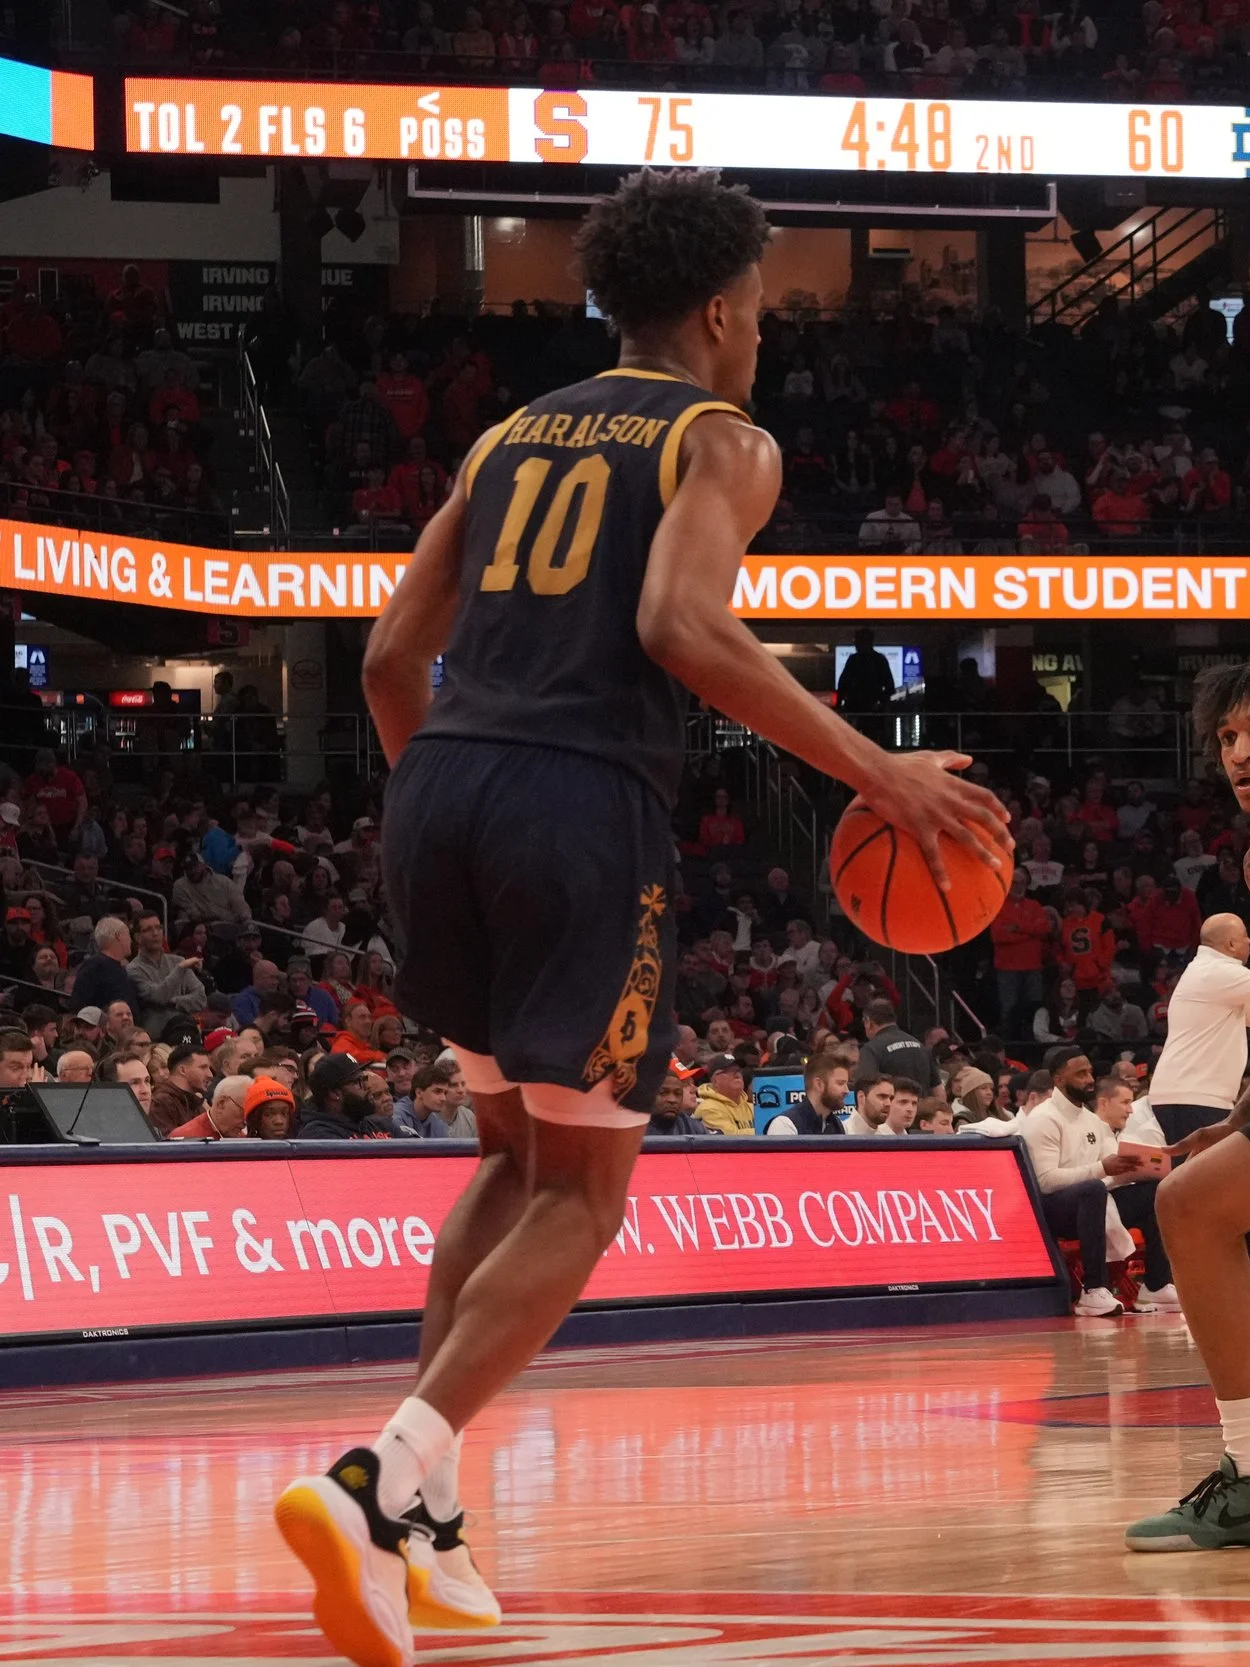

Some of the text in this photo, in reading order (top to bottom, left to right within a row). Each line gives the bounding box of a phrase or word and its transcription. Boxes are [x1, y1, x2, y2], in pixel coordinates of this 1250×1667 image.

[134, 103, 365, 156] TOL 2 FLS 6
[400, 116, 485, 159] POSS
[637, 97, 693, 161] 75
[841, 101, 1034, 172] 4:48 2ND
[1128, 110, 1184, 173] 60
[203, 268, 269, 284] IRVING
[177, 322, 234, 339] WEST
[505, 413, 669, 448] HARALSON
[480, 454, 611, 595] 10
[13, 534, 407, 609] LIVING & LEARNIN
[731, 566, 1247, 611] MODERN STUDENT
[1070, 927, 1092, 955] S
[103, 1211, 214, 1279] PVF
[233, 1208, 285, 1274] &
[286, 1215, 434, 1269] more
[650, 1192, 793, 1252] WEBB
[797, 1188, 1003, 1248] COMPANY
[888, 1284, 919, 1292] DAKTRONICS
[83, 1327, 129, 1338] DAKTRONICS
